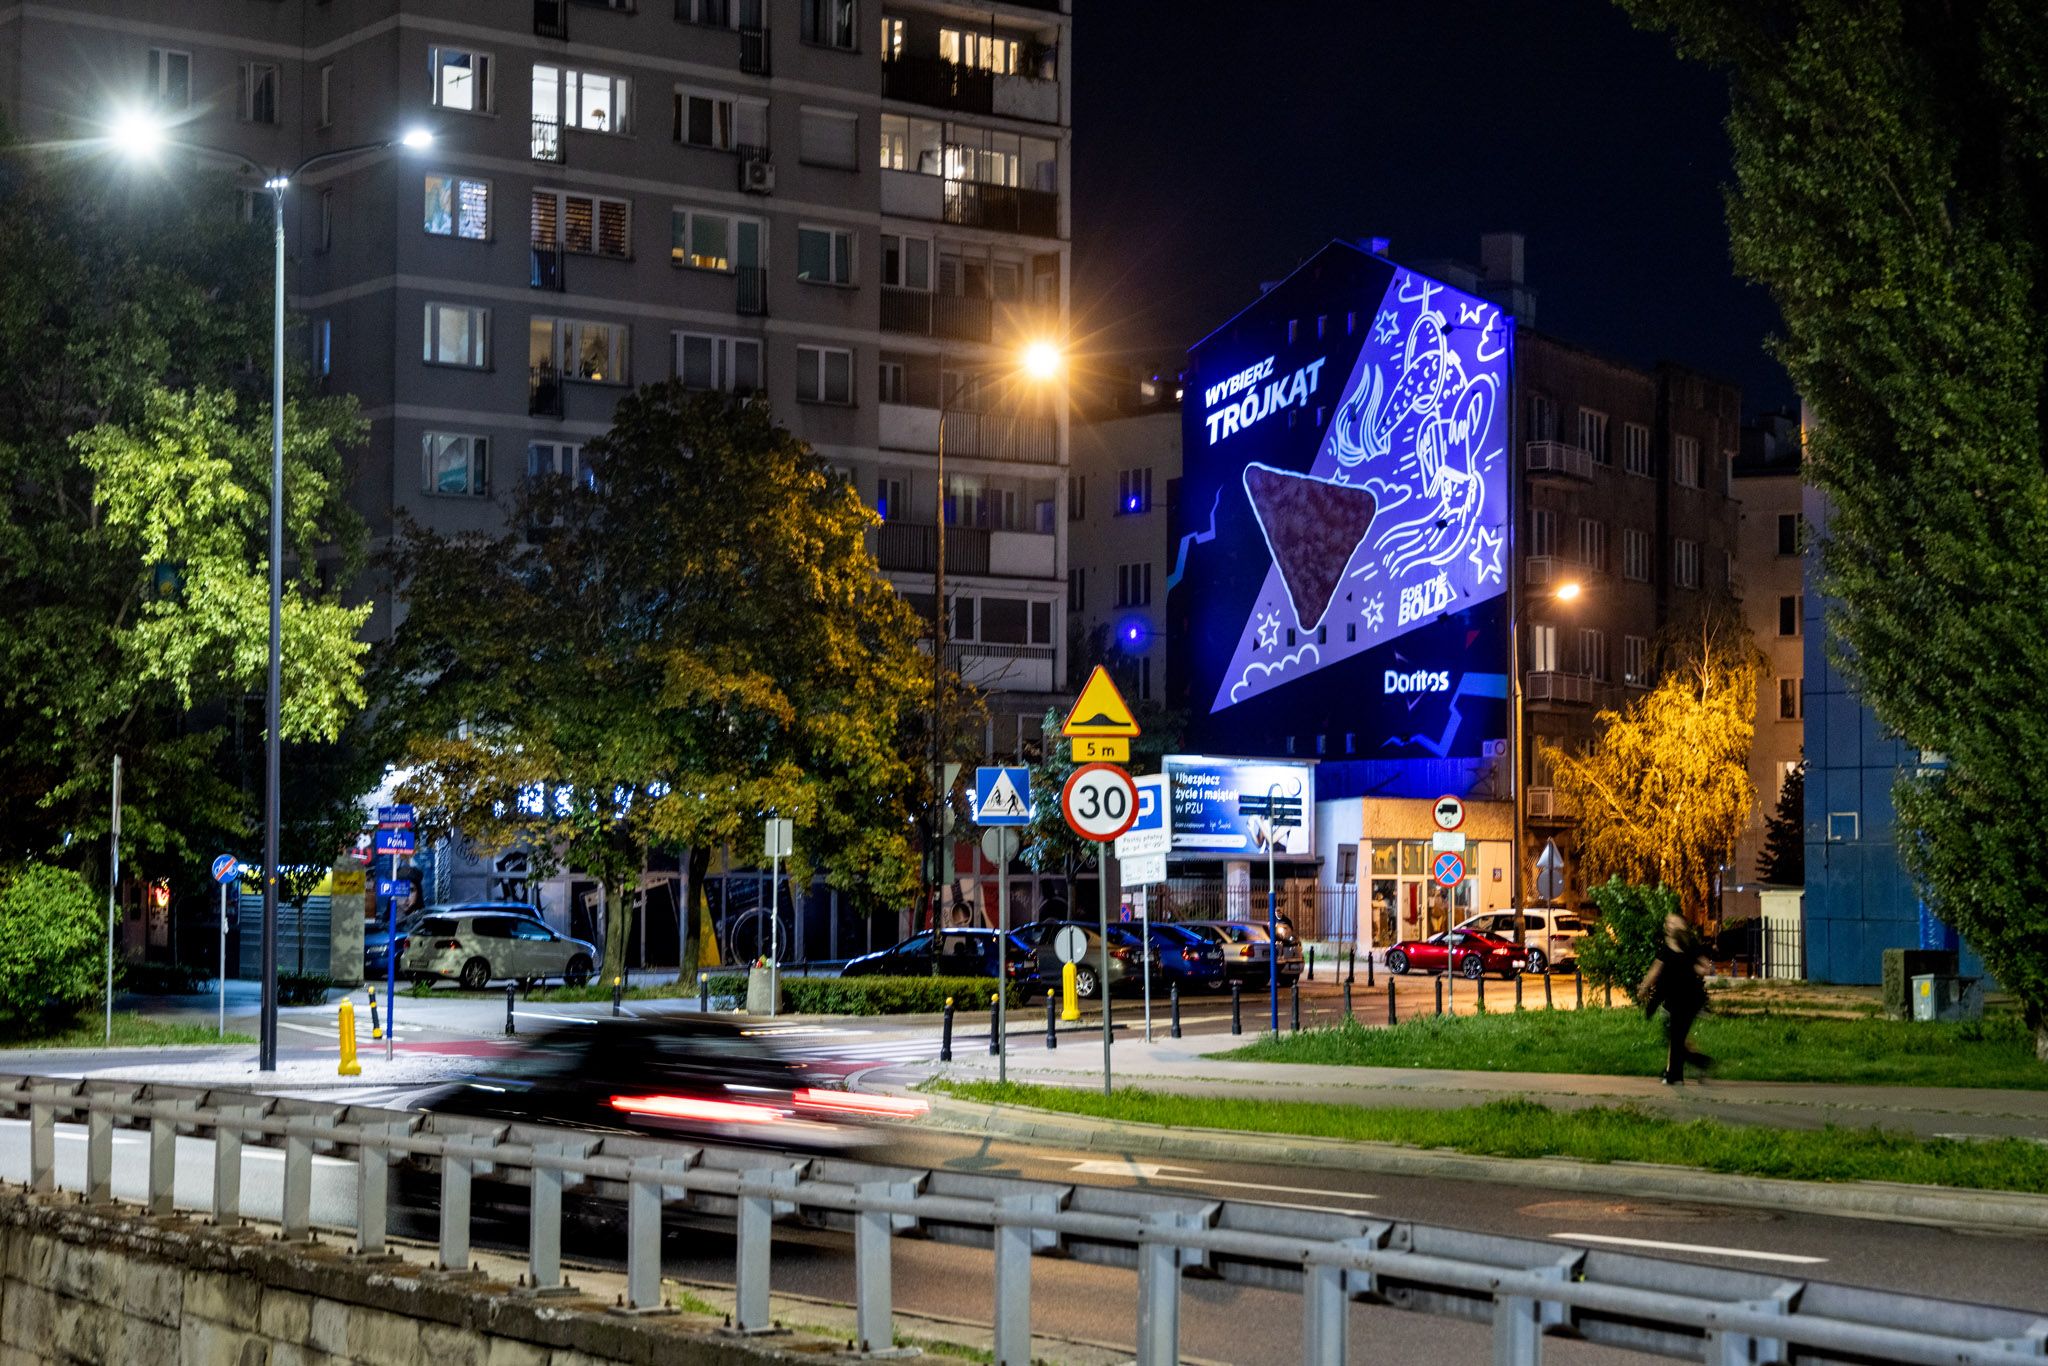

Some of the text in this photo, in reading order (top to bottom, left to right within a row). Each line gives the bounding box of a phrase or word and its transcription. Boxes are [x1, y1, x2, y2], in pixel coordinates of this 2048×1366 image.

[1205, 355, 1275, 408] WYBIERZ
[1205, 356, 1327, 446] TRÓJKĄT
[1400, 571, 1448, 603] FOR THE
[1397, 587, 1449, 627] BOLD
[1384, 669, 1450, 694] Doritos
[1086, 742, 1115, 757] 5 m
[1078, 784, 1126, 820] 30
[1132, 789, 1155, 828] P
[1175, 787, 1198, 801] życie
[1199, 788, 1203, 799] i
[1175, 802, 1204, 815] w PZU
